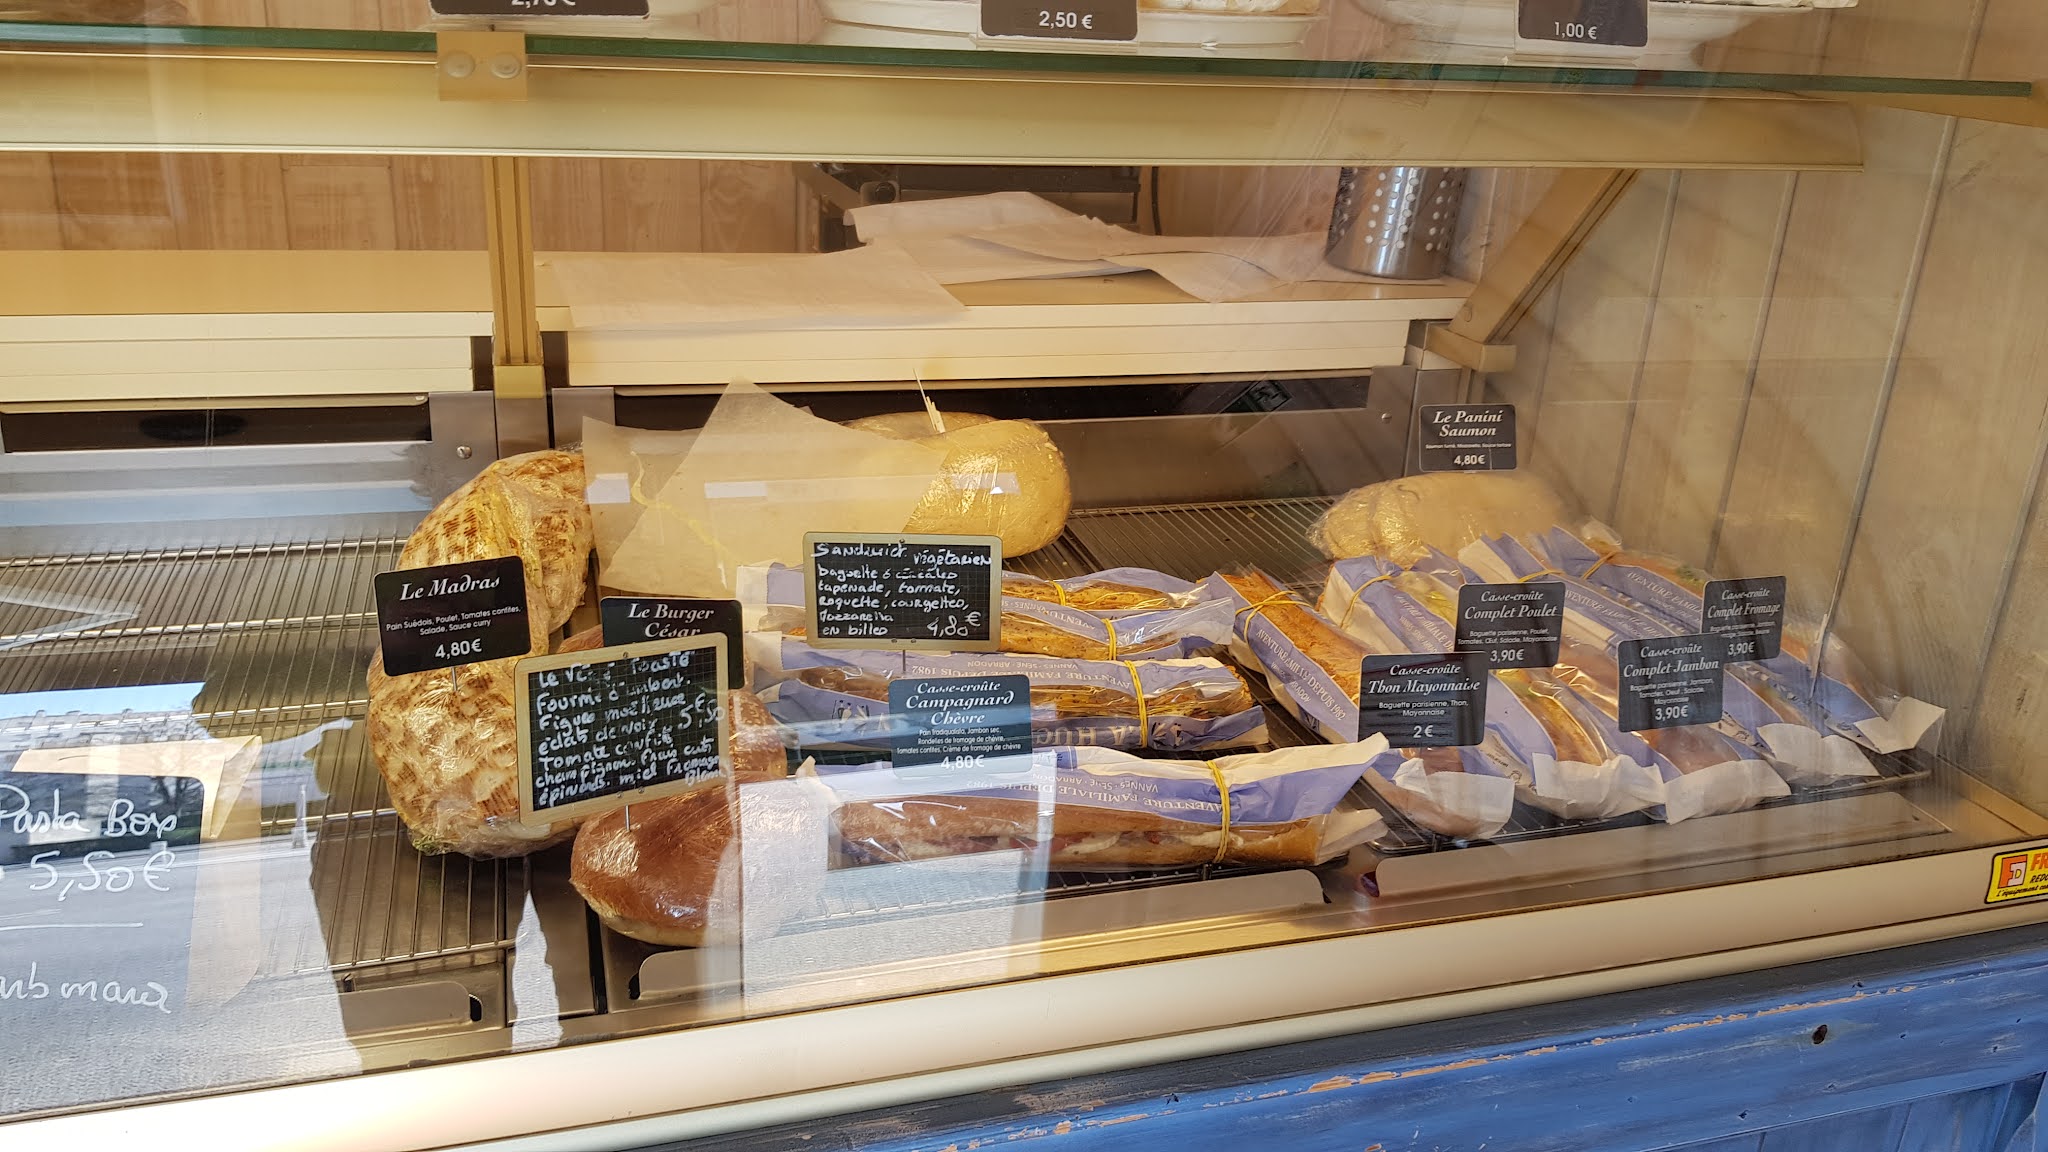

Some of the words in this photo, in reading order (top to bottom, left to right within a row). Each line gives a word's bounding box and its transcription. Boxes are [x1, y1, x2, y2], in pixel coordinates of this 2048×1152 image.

[1038, 10, 1077, 29] 2,50
[1554, 21, 1585, 39] 1,00
[1432, 410, 1452, 424] Le
[1454, 409, 1504, 424] Panini
[1439, 423, 1497, 437] Saumon
[1453, 454, 1486, 467] 4,80€
[399, 582, 425, 601] Le
[427, 574, 501, 598] Madras
[1480, 590, 1544, 602] Casse-croûte
[627, 602, 650, 619] Le
[653, 603, 715, 624] Burger
[1464, 604, 1517, 623] Complet
[1517, 603, 1559, 618] Poulet
[1707, 603, 1743, 621] Complet
[1743, 602, 1781, 617] Fromage
[386, 622, 403, 632] Pain
[449, 622, 472, 633] Sauce
[644, 621, 702, 638] César
[434, 637, 483, 660] 4,80€
[1489, 649, 1525, 663] 3,90€
[1640, 643, 1703, 658] Casse-croûte
[1728, 641, 1755, 657] 3,90€
[911, 664, 937, 676] 1982
[1389, 663, 1461, 676] Casse-croûte
[1623, 660, 1673, 679] Complet
[1673, 656, 1720, 673] Jambon
[917, 680, 1001, 694] Casse-croûte
[1368, 679, 1400, 694] Thon
[1402, 677, 1480, 696] Mayonnaise
[905, 690, 1015, 712] Campagnard
[1307, 676, 1335, 708] DEPUIS
[1330, 703, 1347, 721] 1982
[930, 710, 986, 726] Chèvre
[1654, 704, 1689, 721] 3,90€
[976, 735, 984, 743] de
[961, 744, 970, 752] de
[993, 743, 1002, 751] de
[940, 754, 985, 771] 4,80€
